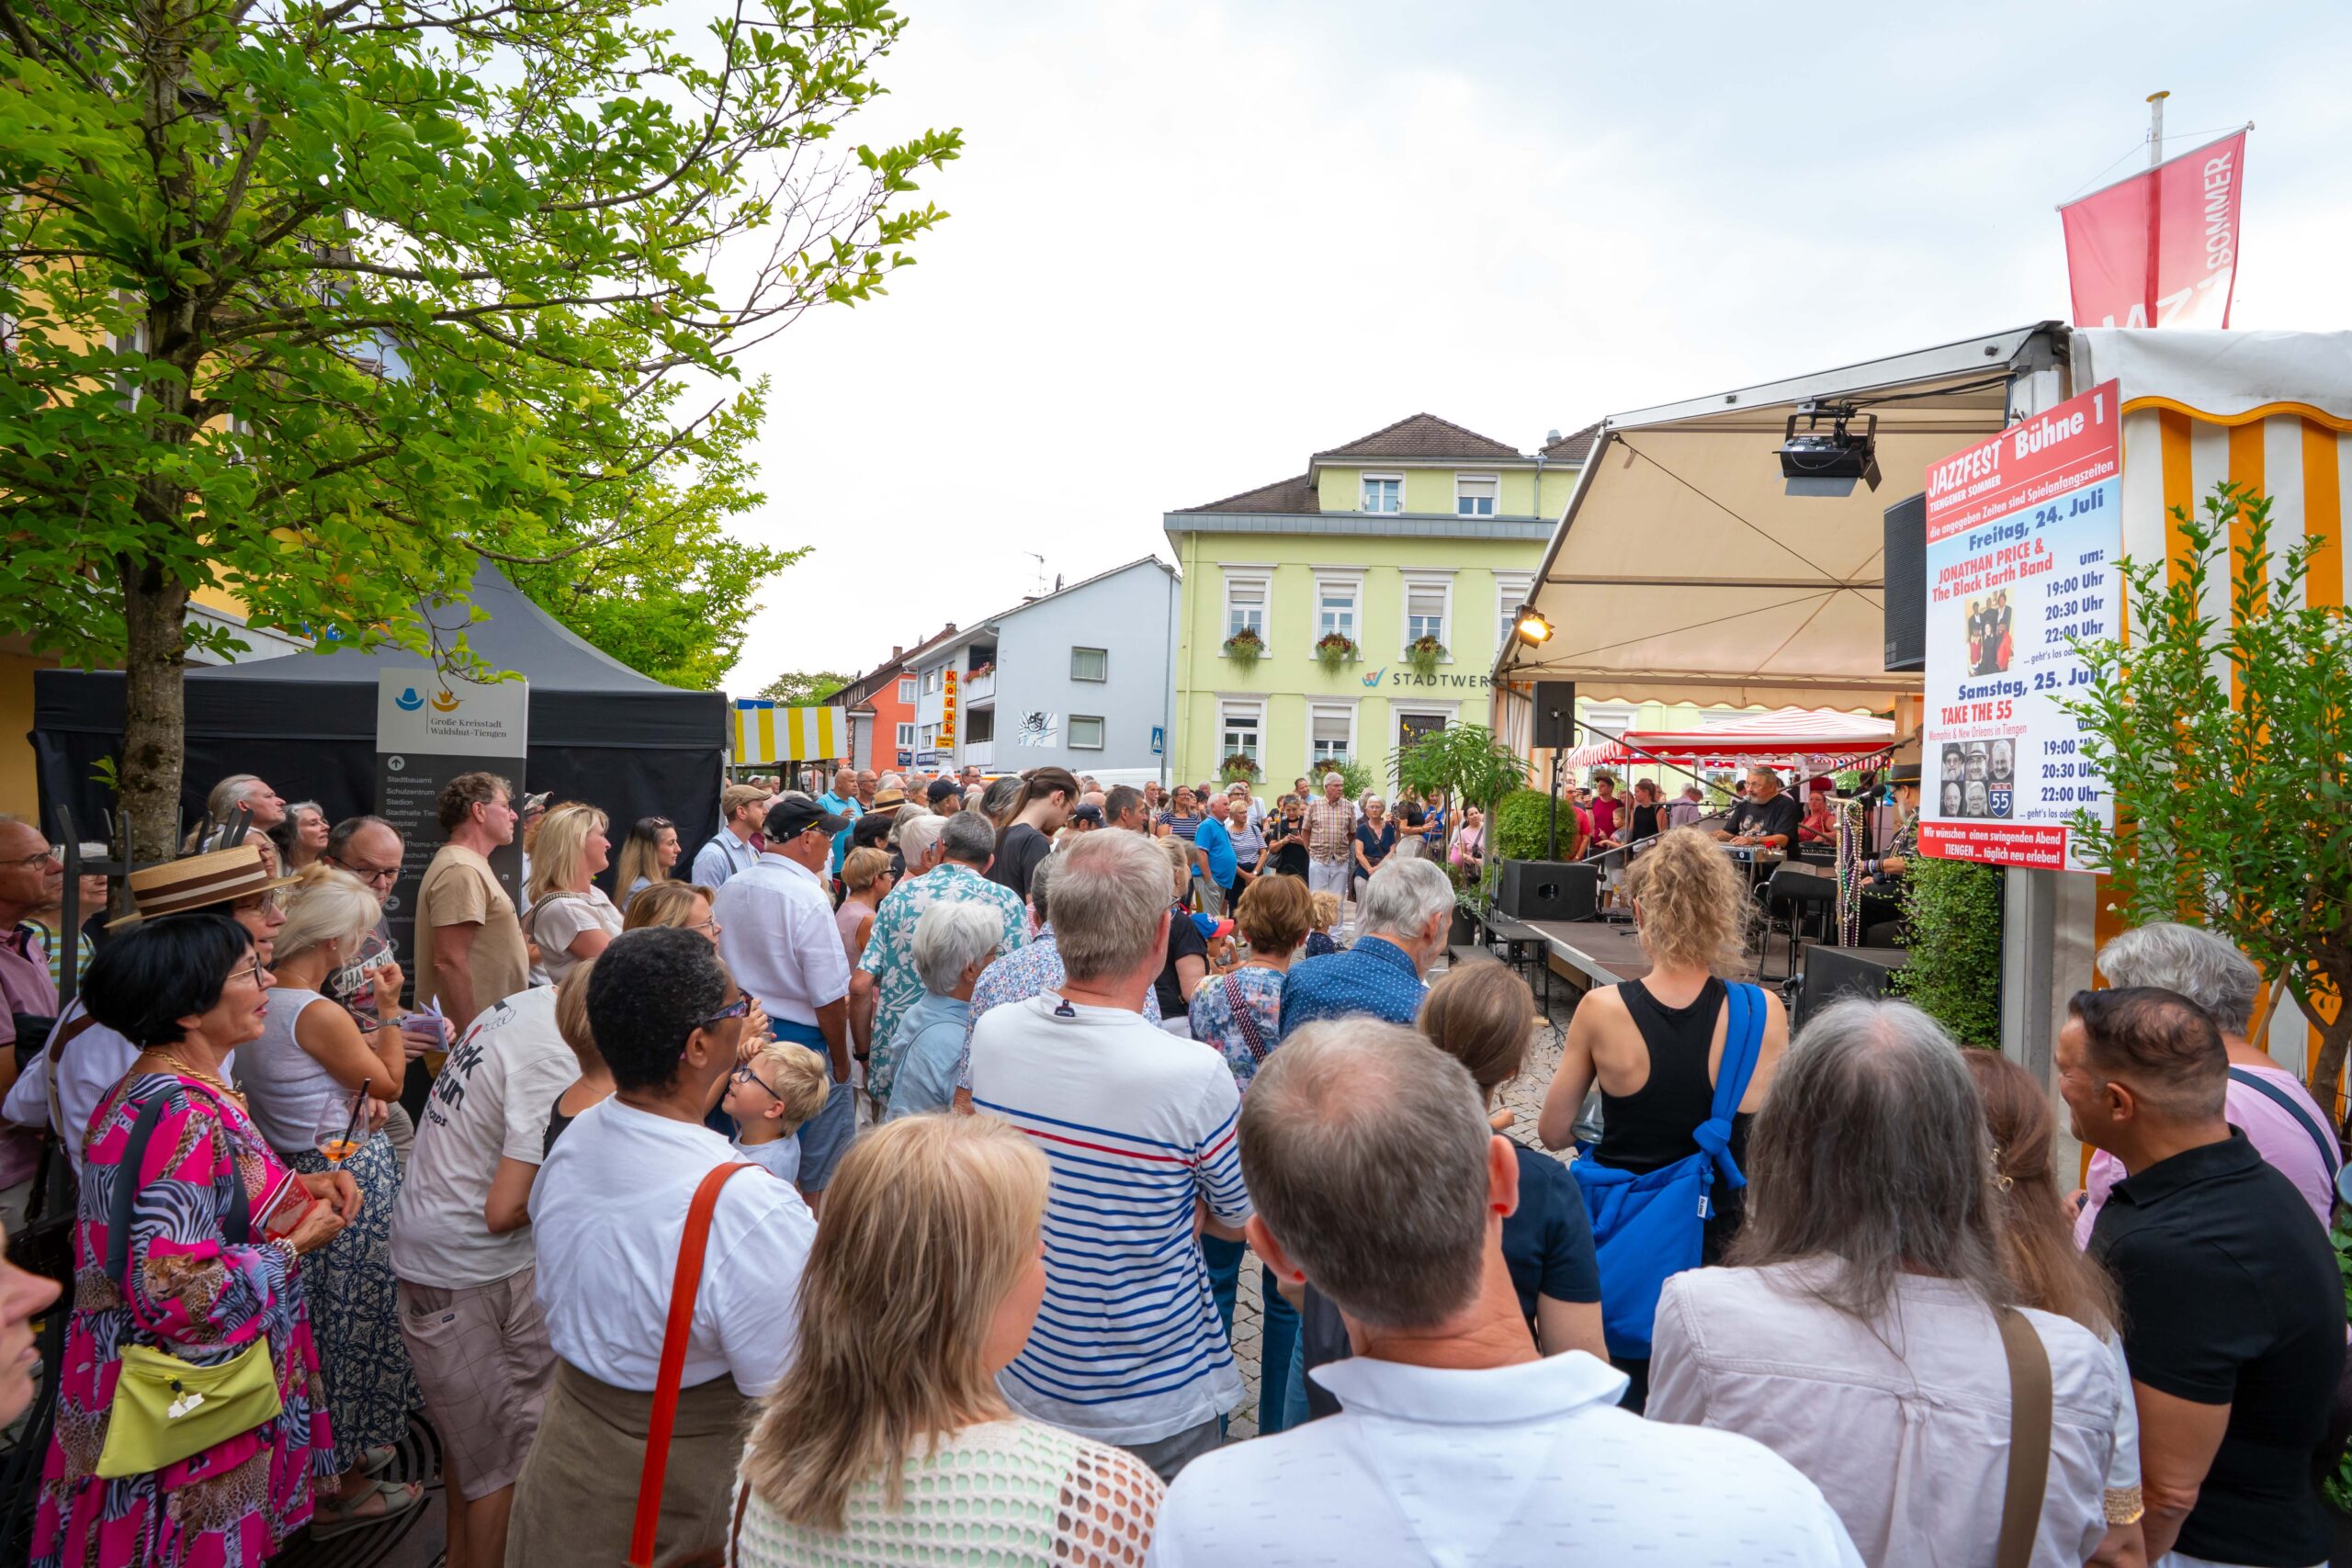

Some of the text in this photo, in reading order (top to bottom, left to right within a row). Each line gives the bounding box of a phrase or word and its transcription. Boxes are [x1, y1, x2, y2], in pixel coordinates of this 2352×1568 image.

[2204, 152, 2233, 270] SOMMER
[1928, 393, 2104, 498] JAZZFEST Bühne 1
[1929, 475, 2001, 513] TIENGENER SOMMER
[1929, 460, 2114, 539] die angegeben Zeiten sind Spielanfangszeiten
[1969, 488, 2104, 551] Freitag, 24. Juli
[1939, 537, 2044, 584] JONATHAN PRICE &
[2079, 548, 2104, 566] um:
[1932, 551, 2052, 603] The Black Earth Band
[2046, 570, 2104, 597] 19:00 Uhr
[2045, 595, 2104, 621] 20:30 Uhr
[2045, 619, 2104, 643] 22:00 Uhr
[2030, 650, 2051, 665] geht's
[2052, 649, 2063, 660] los
[2064, 645, 2078, 657] ode
[1958, 680, 2028, 701] Samstag,
[2034, 671, 2062, 690] 25.
[944, 671, 956, 734] Kodak
[1941, 699, 2013, 726] TAKE THE 55
[430, 717, 502, 728] Große Kreisstadt
[1928, 723, 2028, 741] Memphis & New Orleans in Tiengen
[430, 727, 507, 739] Waldshut-Tiengen
[2042, 739, 2075, 755] 19:00
[387, 775, 433, 784] Stadtbauamt
[2041, 762, 2075, 779] 20:30
[386, 787, 435, 796] Schulzentrum
[1992, 793, 2009, 809] 55
[2041, 786, 2099, 802] 22:00 Uhr
[385, 808, 422, 817] Stadthalle
[2027, 810, 2047, 820] geht's
[2048, 810, 2057, 818] los
[391, 820, 418, 829] estplatz
[1923, 826, 1935, 839] Wir
[1936, 827, 1966, 840] wünschen
[1969, 829, 1988, 840] einen
[1989, 829, 2034, 846] swingenden
[2035, 831, 2061, 845] Abend
[1945, 842, 1973, 857] TIENGEN
[1984, 846, 2008, 862] täglich
[2010, 852, 2025, 862] neu
[2027, 851, 2060, 864] erleben!
